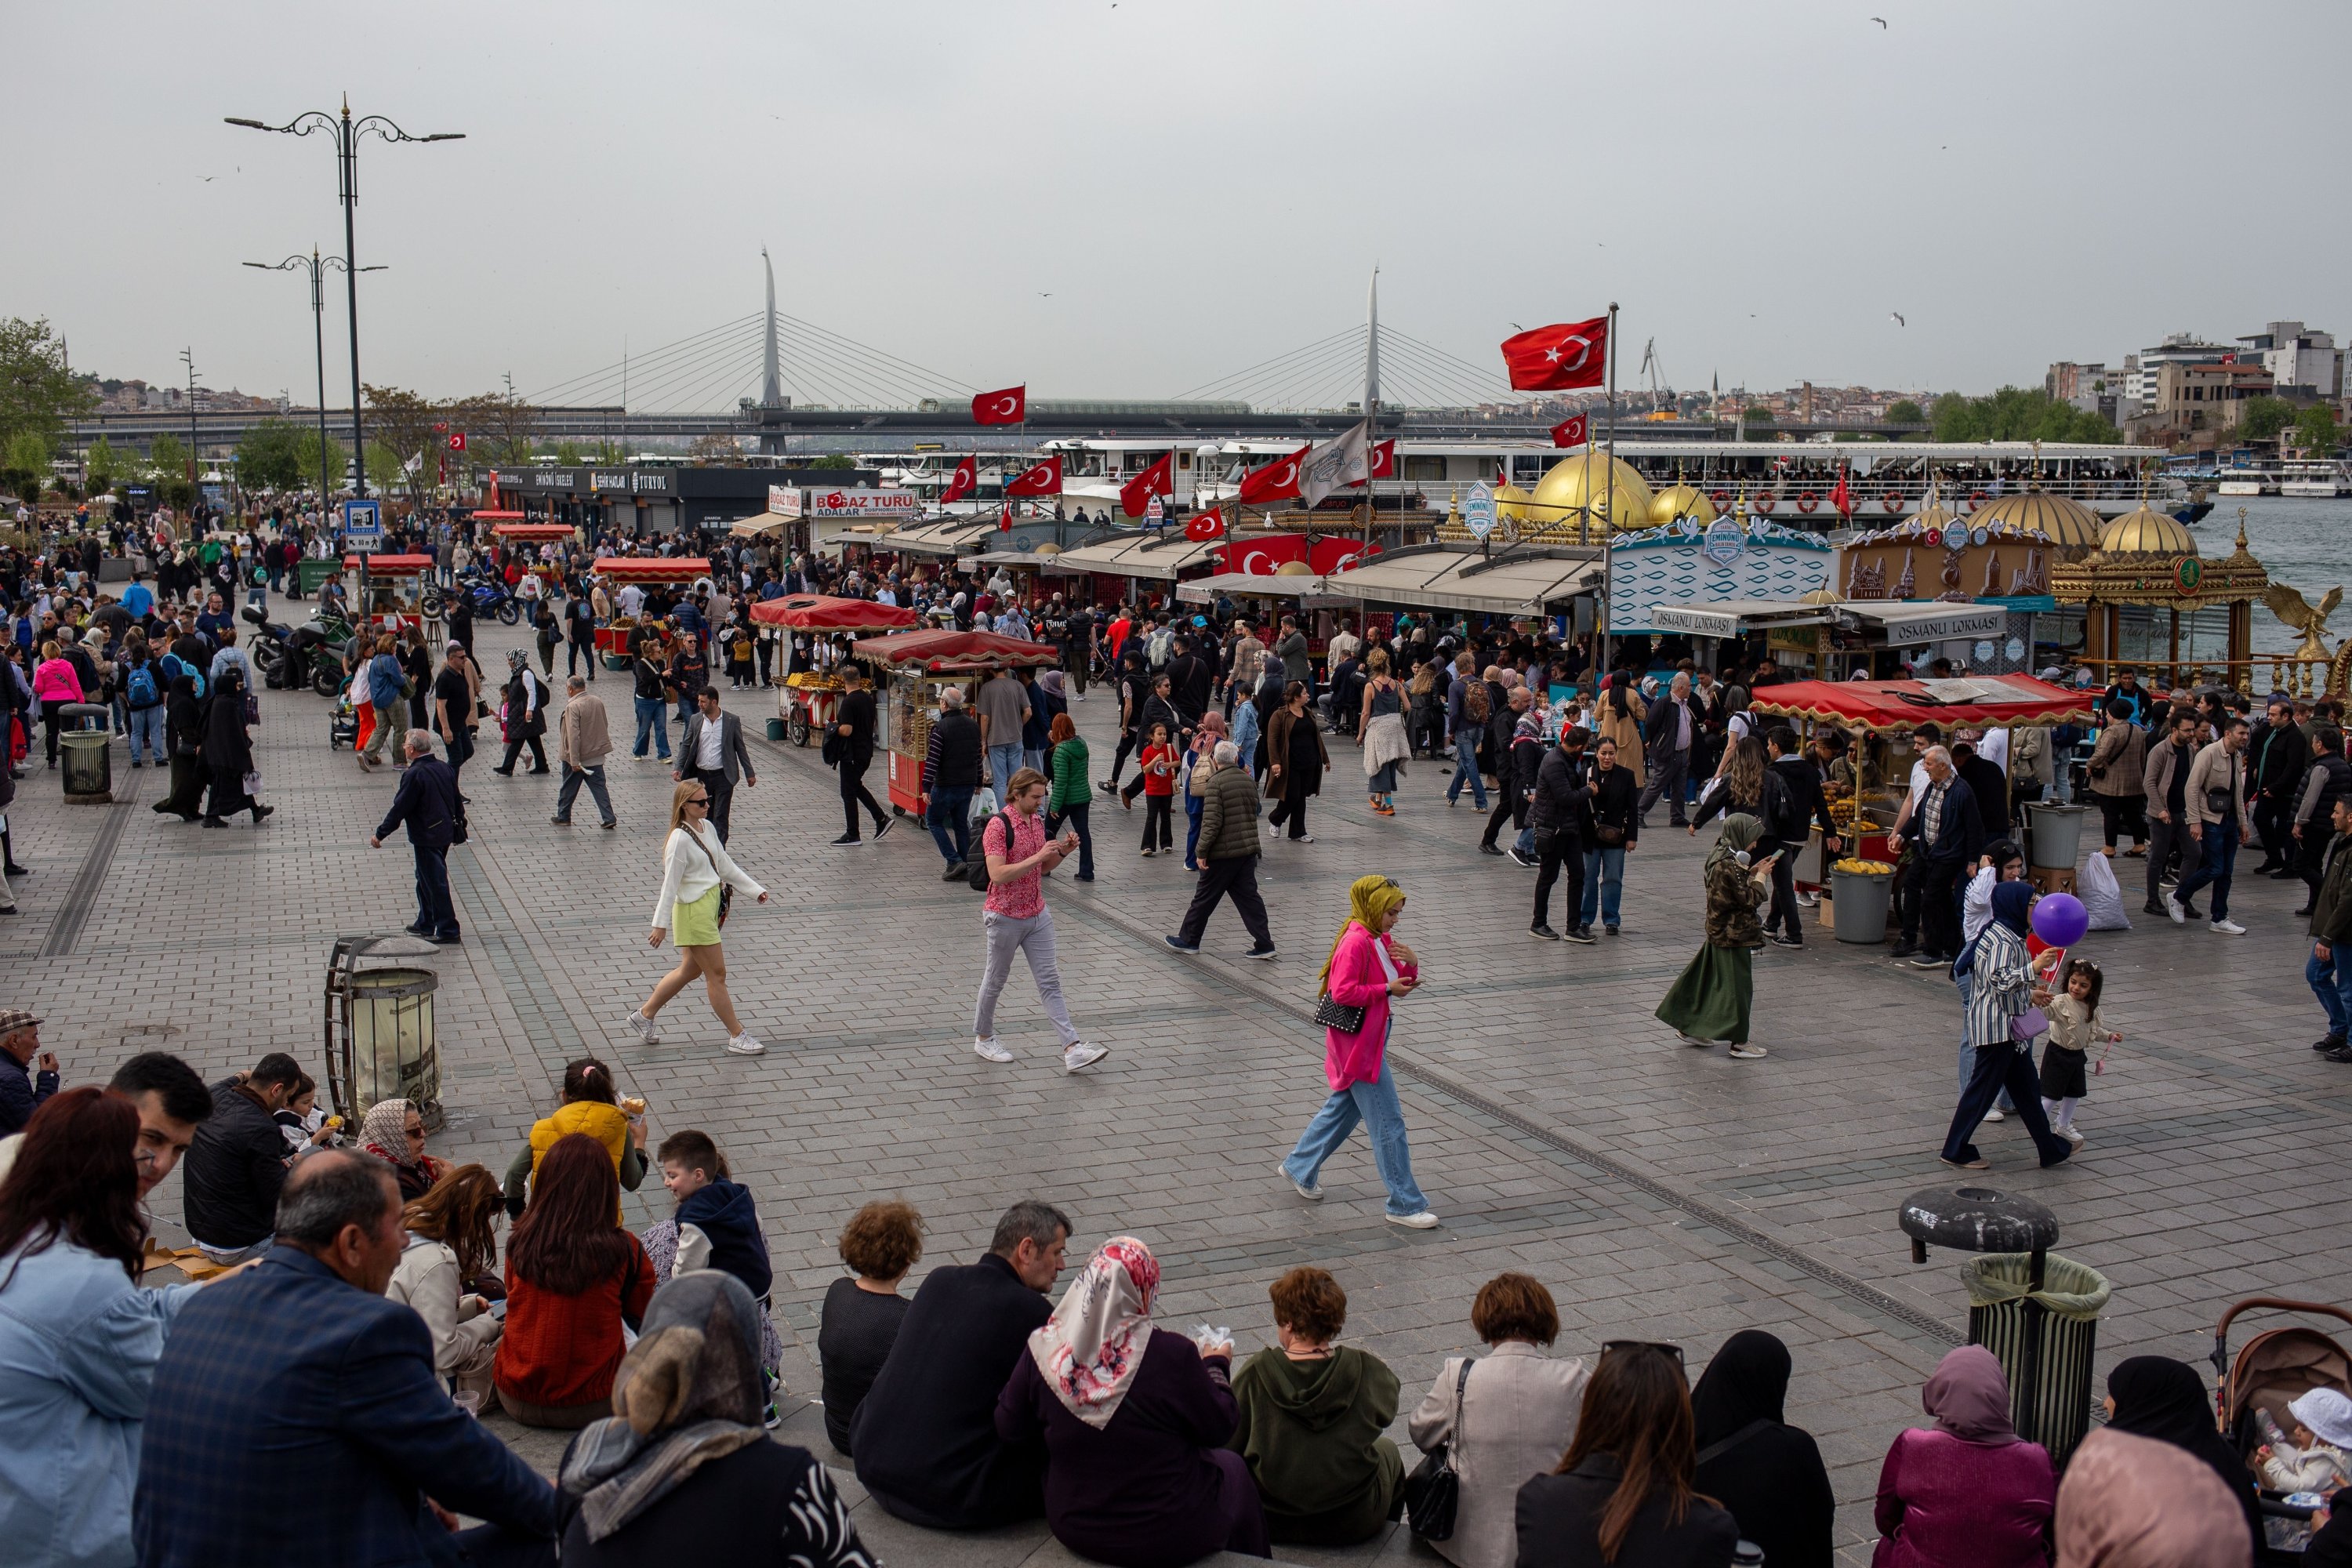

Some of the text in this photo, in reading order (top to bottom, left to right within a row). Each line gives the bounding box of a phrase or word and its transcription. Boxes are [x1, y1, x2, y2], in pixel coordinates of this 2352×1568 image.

[535, 471, 574, 487] EMİNÖNÜ İSKELESİ
[597, 472, 626, 490] ŞEHİR HATLARI
[640, 475, 666, 490] TURYOL
[817, 507, 860, 517] ADALAR
[1469, 500, 1490, 512] EMİNÖNÜ
[1711, 532, 1740, 542] EMİNÖNÜ
[1658, 613, 1730, 631] OSMANLI LOKMASI
[1899, 616, 1998, 639] OSMANLI LOKMASI
